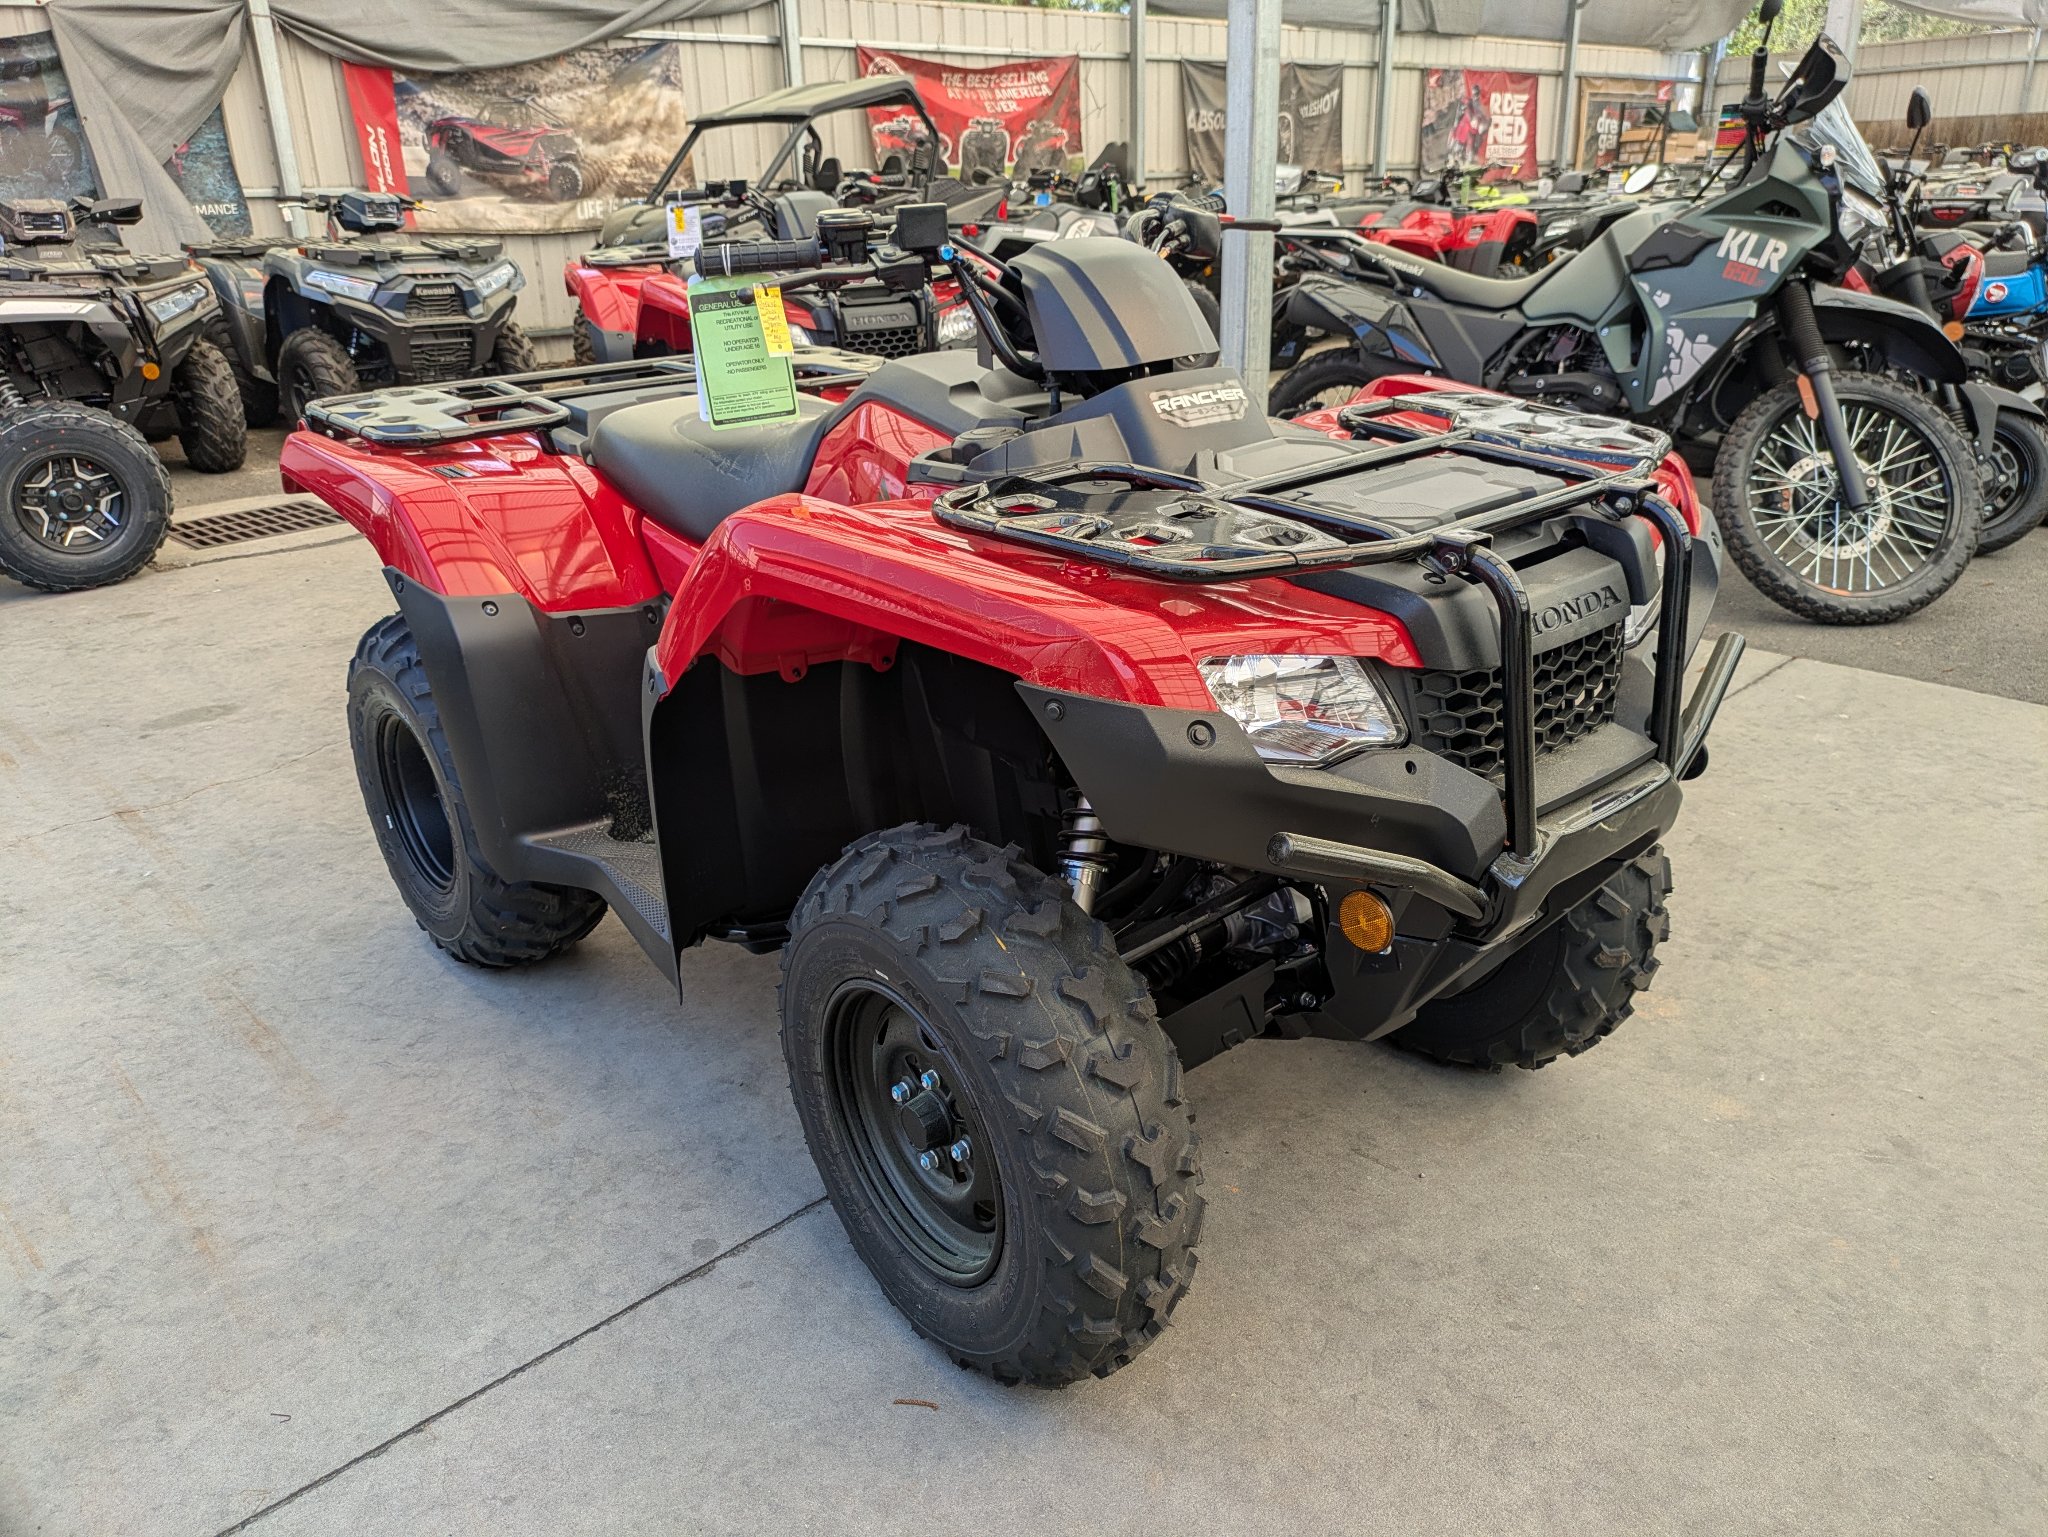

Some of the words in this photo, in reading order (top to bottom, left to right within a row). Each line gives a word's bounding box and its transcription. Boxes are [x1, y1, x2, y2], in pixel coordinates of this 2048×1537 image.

[941, 72, 964, 87] THE
[966, 71, 1049, 88] BEST-SELLING
[1187, 108, 1226, 132] ABSOL
[1487, 116, 1529, 145] RED
[193, 203, 240, 216] MANCE
[577, 200, 605, 220] LIFE
[1716, 227, 1788, 274] KLR
[415, 285, 456, 296] Kawasaki
[698, 301, 731, 311] GENERAL
[851, 312, 910, 326] HONDA
[1152, 388, 1247, 414] RANCHER
